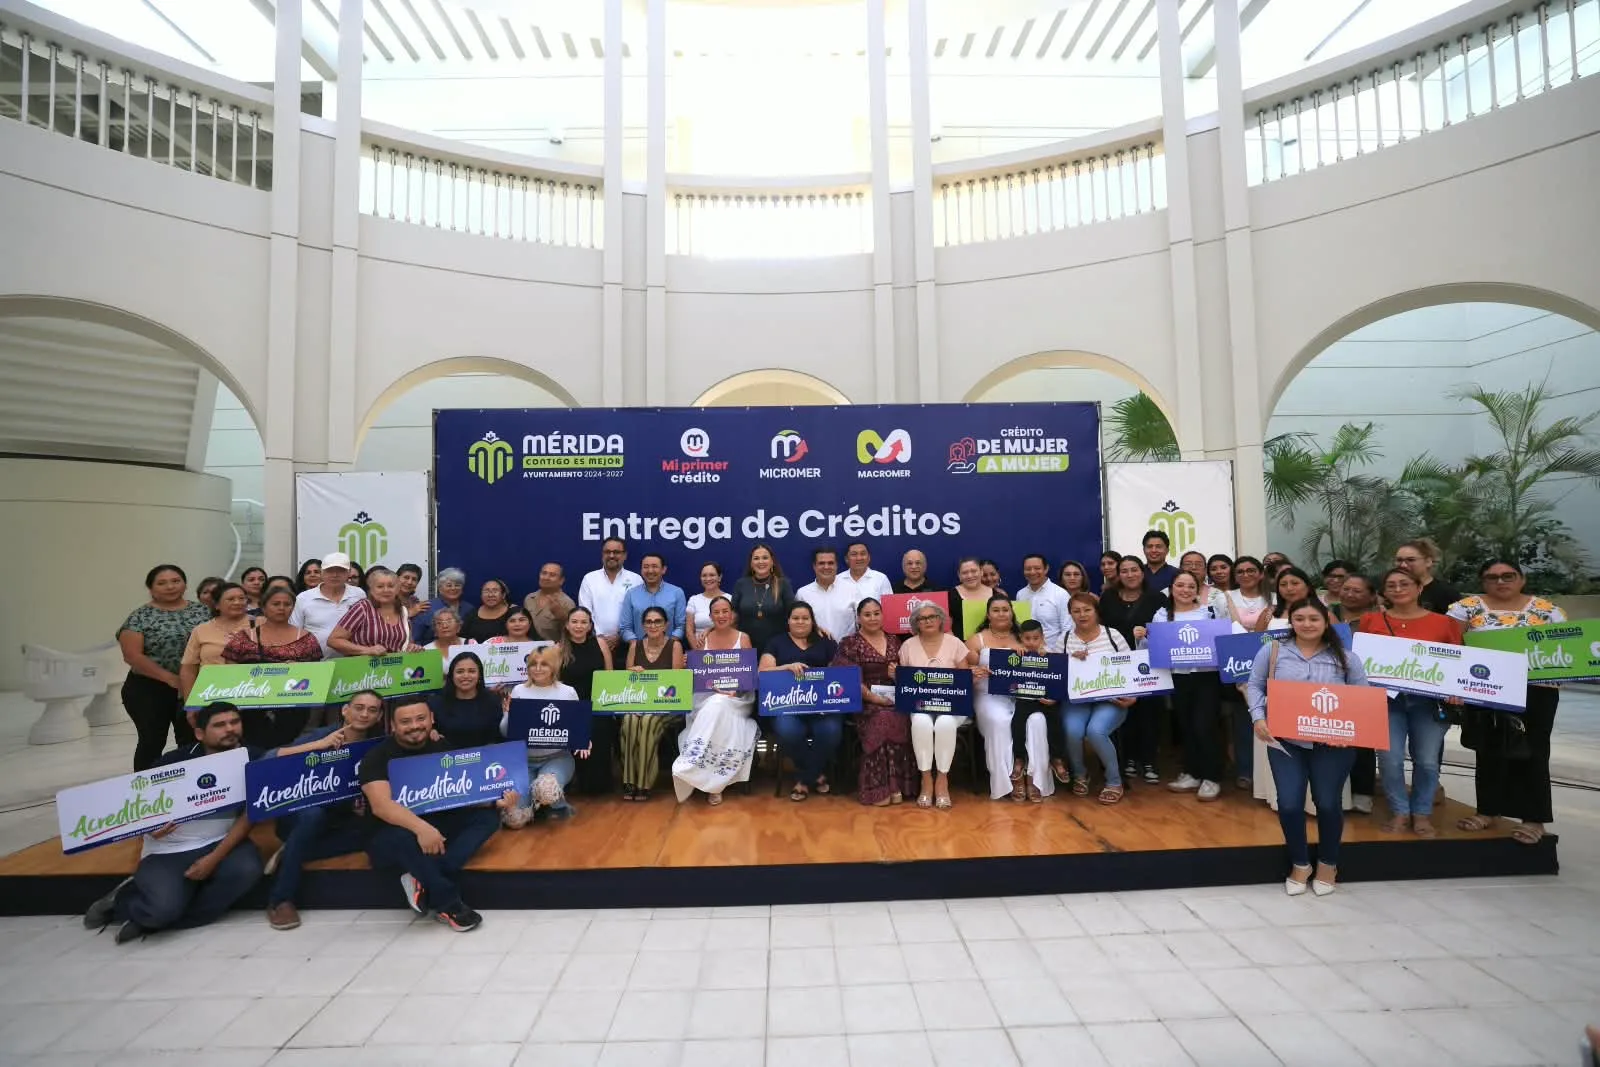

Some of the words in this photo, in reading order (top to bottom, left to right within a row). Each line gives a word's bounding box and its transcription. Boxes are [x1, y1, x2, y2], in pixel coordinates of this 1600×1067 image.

[1000, 426, 1044, 437] CRÉDITO
[523, 431, 624, 454] MÉRIDA
[977, 439, 1001, 454] DE
[1004, 437, 1068, 453] MUJER
[525, 458, 570, 466] CONTIGO
[588, 457, 621, 466] MEJOR
[662, 459, 679, 471] Mi
[681, 459, 728, 473] primer
[985, 457, 999, 471] A
[1001, 456, 1061, 471] MUJER
[670, 471, 720, 483] crédito
[759, 467, 821, 479] MICROMER
[857, 469, 911, 479] MACROMER
[582, 511, 732, 549] Entrega
[741, 509, 789, 539] de
[799, 504, 961, 537] Créditos
[1170, 646, 1212, 655] MÉRIDA
[332, 668, 393, 694] Acreditado
[994, 668, 1012, 677] ¡Soy
[1012, 669, 1062, 680] beneficiaria!
[1072, 668, 1127, 692] Acreditado
[199, 679, 271, 699] Acreditado
[901, 686, 918, 695] ¡Soy
[918, 687, 967, 696] beneficiaria!
[1469, 680, 1503, 690] primer
[597, 684, 648, 704] Acreditado
[762, 684, 818, 708] Acreditado
[1297, 715, 1355, 730] MÉRIDA
[528, 727, 569, 737] MÉRIDA
[253, 767, 340, 808] Acreditado
[396, 770, 473, 807] Acreditado
[480, 780, 514, 792] MICROMER
[187, 793, 199, 803] Mi
[200, 786, 231, 801] primer
[194, 793, 226, 807] crédito
[70, 789, 174, 838] Acreditado
